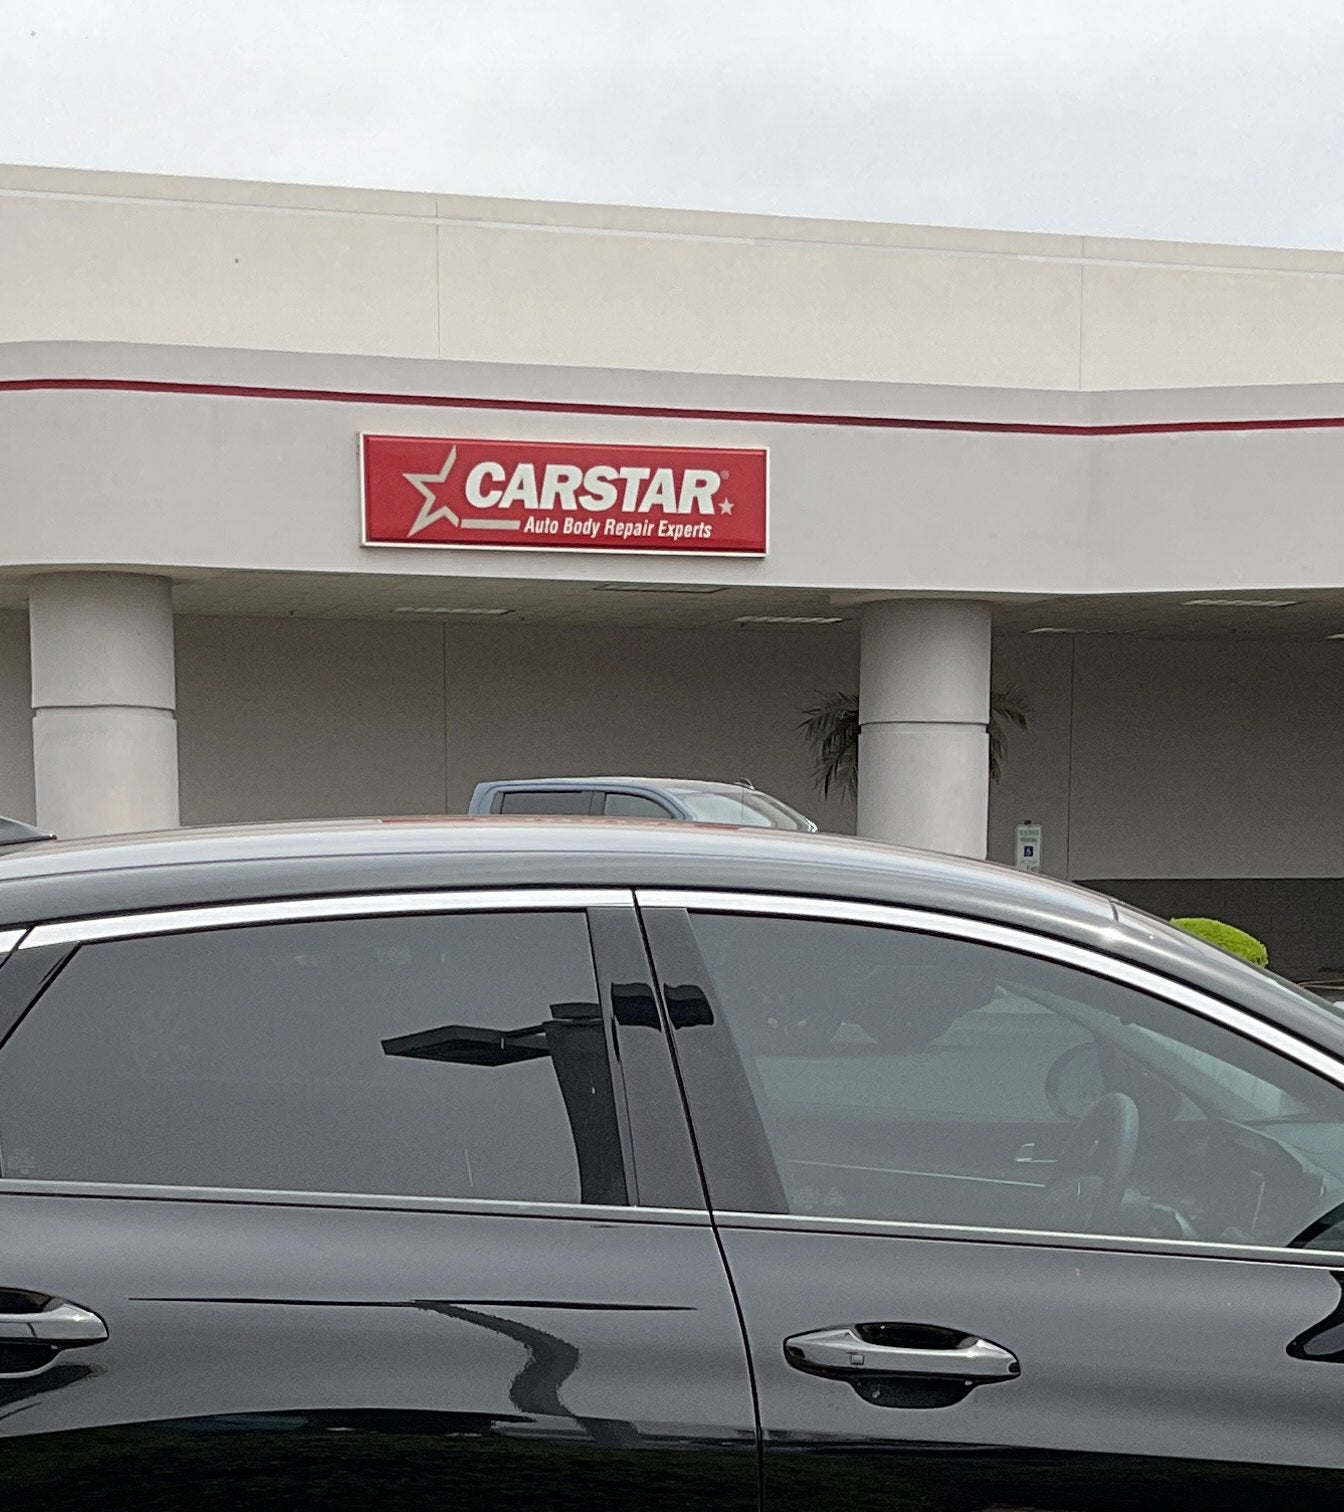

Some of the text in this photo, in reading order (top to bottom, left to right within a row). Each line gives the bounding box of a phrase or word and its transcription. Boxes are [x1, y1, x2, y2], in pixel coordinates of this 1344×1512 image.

[465, 461, 721, 515] CARSTAR
[523, 516, 712, 541] Auto Body Repair Experts
